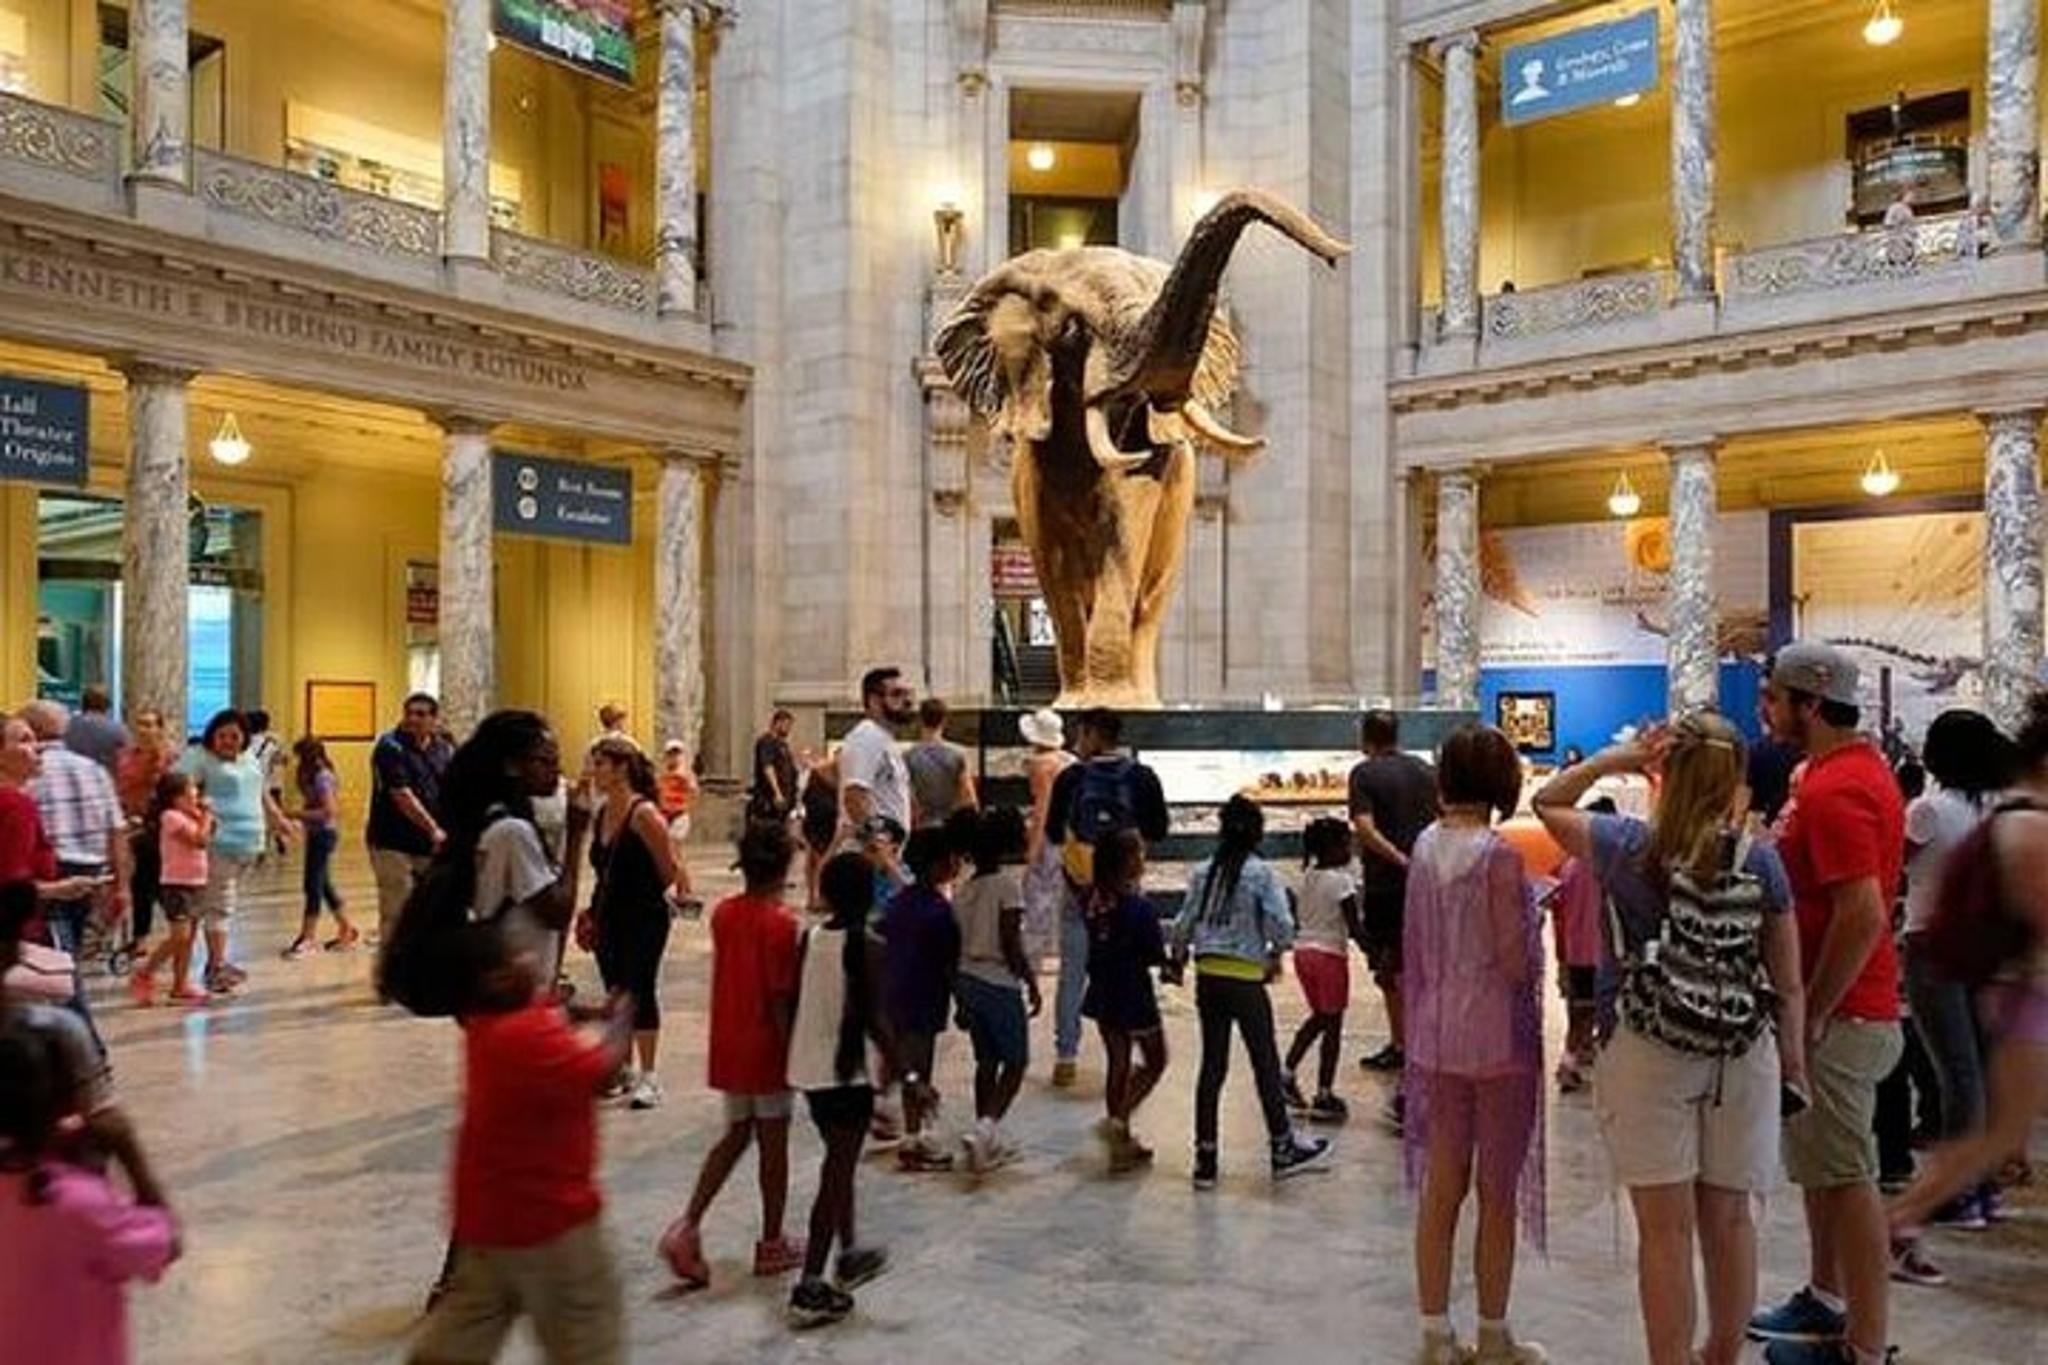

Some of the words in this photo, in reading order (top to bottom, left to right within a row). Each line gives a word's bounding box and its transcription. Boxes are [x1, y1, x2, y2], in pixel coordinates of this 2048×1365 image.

[2, 255, 172, 314] KENNETH
[225, 299, 357, 349] BEHRING
[371, 335, 465, 368] FAMILY
[472, 351, 588, 390] ROTUNDA
